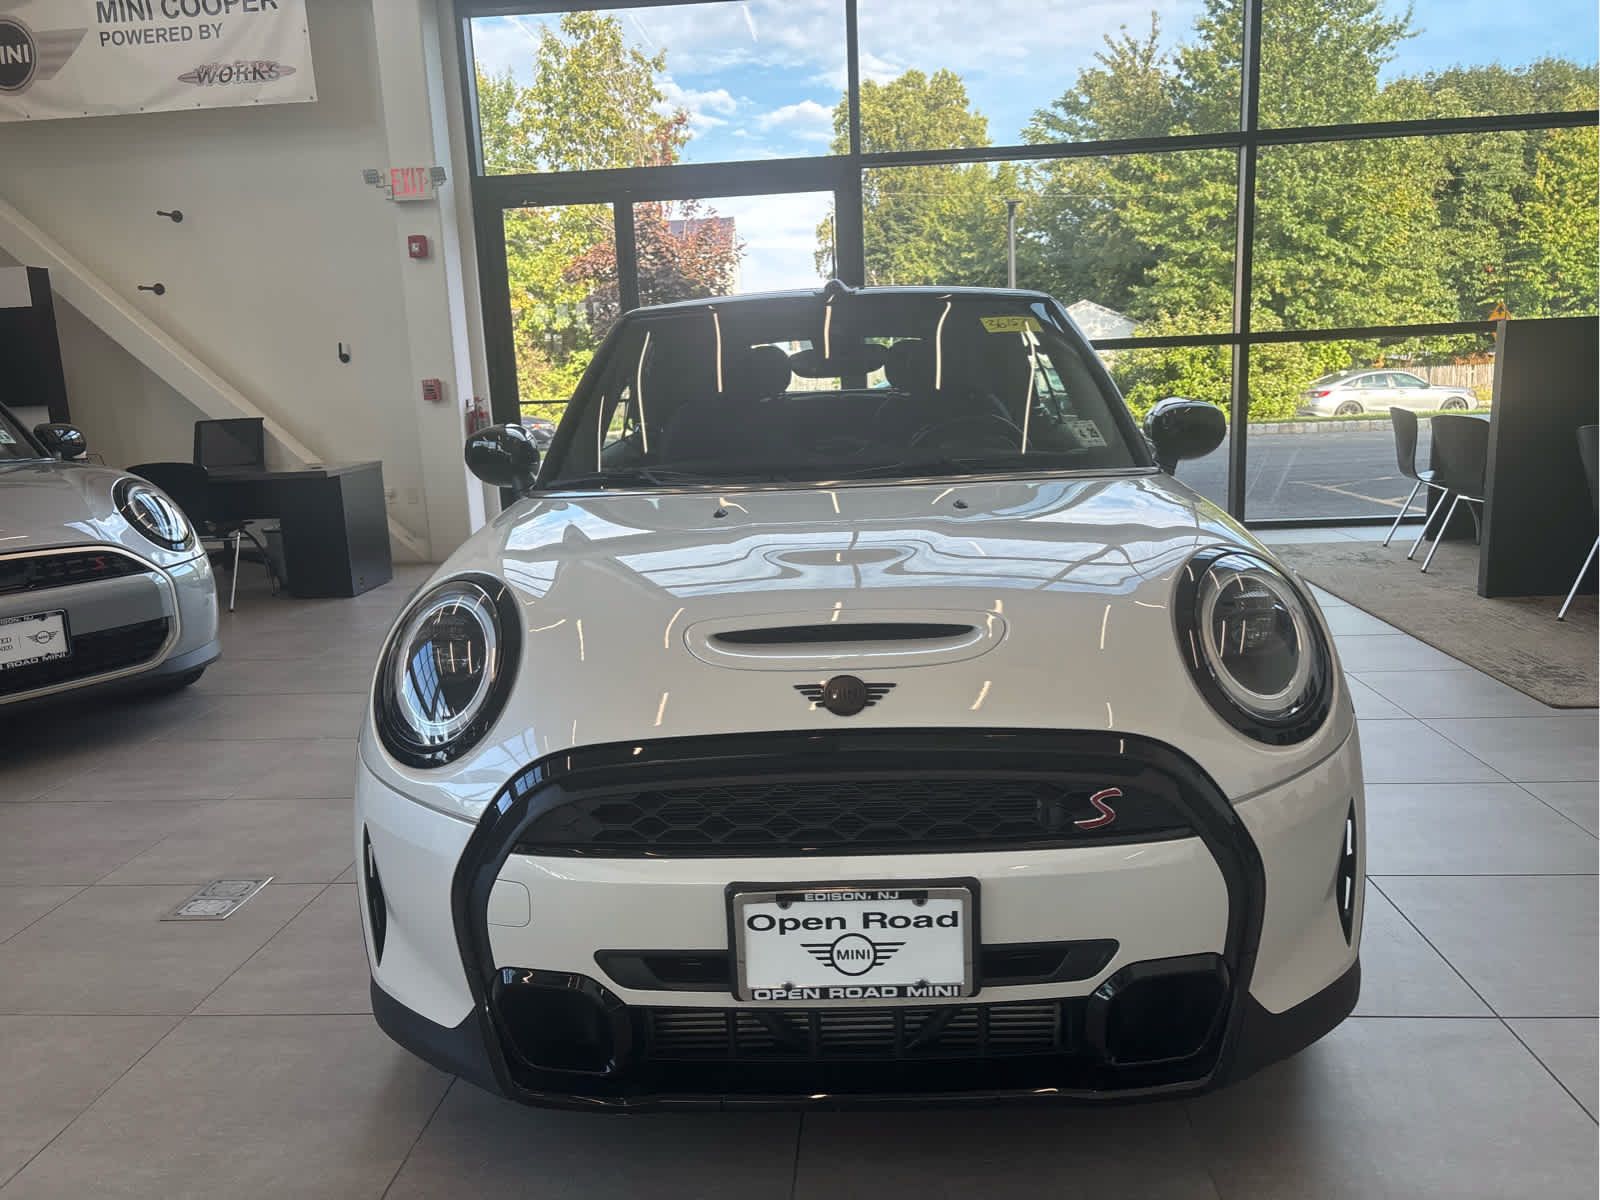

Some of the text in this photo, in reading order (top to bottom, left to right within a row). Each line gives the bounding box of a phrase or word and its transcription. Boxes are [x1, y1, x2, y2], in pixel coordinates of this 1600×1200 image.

[96, 0, 154, 23] MINI
[100, 23, 223, 47] POWERED BY
[0, 44, 30, 65] INI
[391, 167, 425, 195] EXIT
[1074, 787, 1122, 829] S
[878, 891, 899, 899] NJ
[747, 911, 959, 935] Open Road
[836, 949, 871, 960] MINI
[754, 985, 959, 1000] OPEN ROAD MINI
